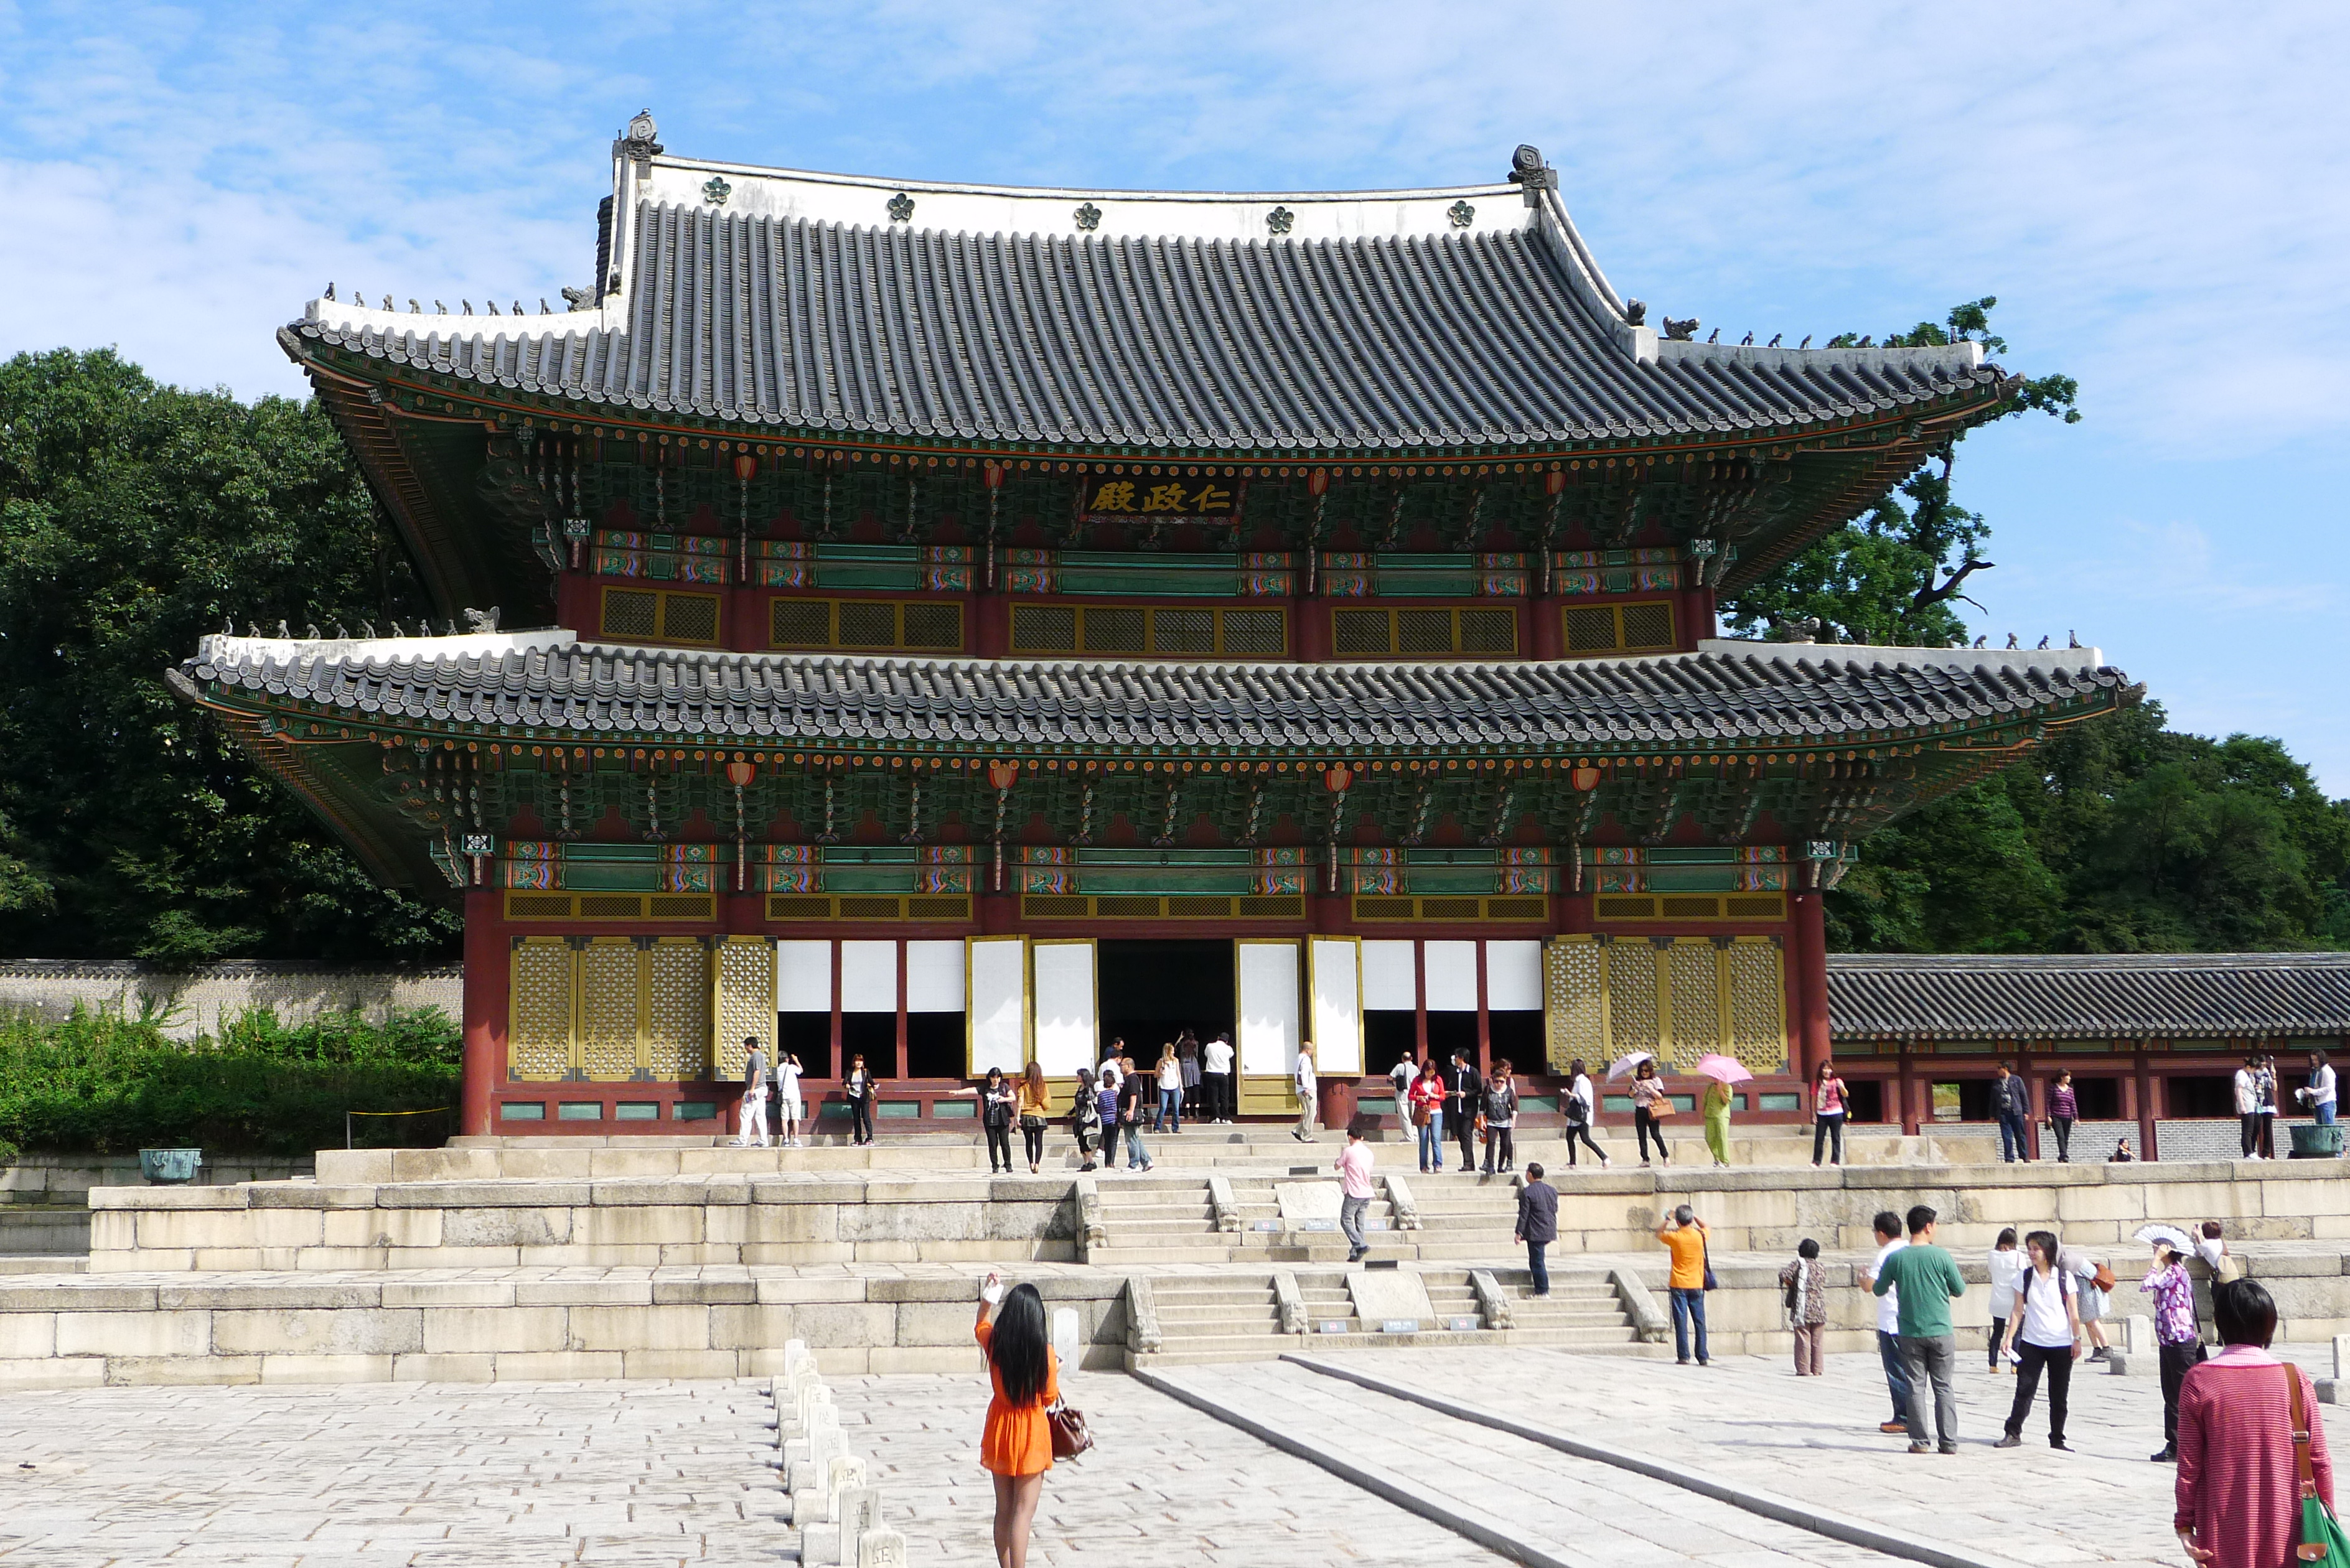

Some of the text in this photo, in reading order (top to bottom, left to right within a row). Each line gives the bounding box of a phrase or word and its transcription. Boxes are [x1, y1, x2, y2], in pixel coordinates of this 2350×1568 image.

[1090, 481, 1230, 512] 仁政殿
[873, 1546, 892, 1564] 正
